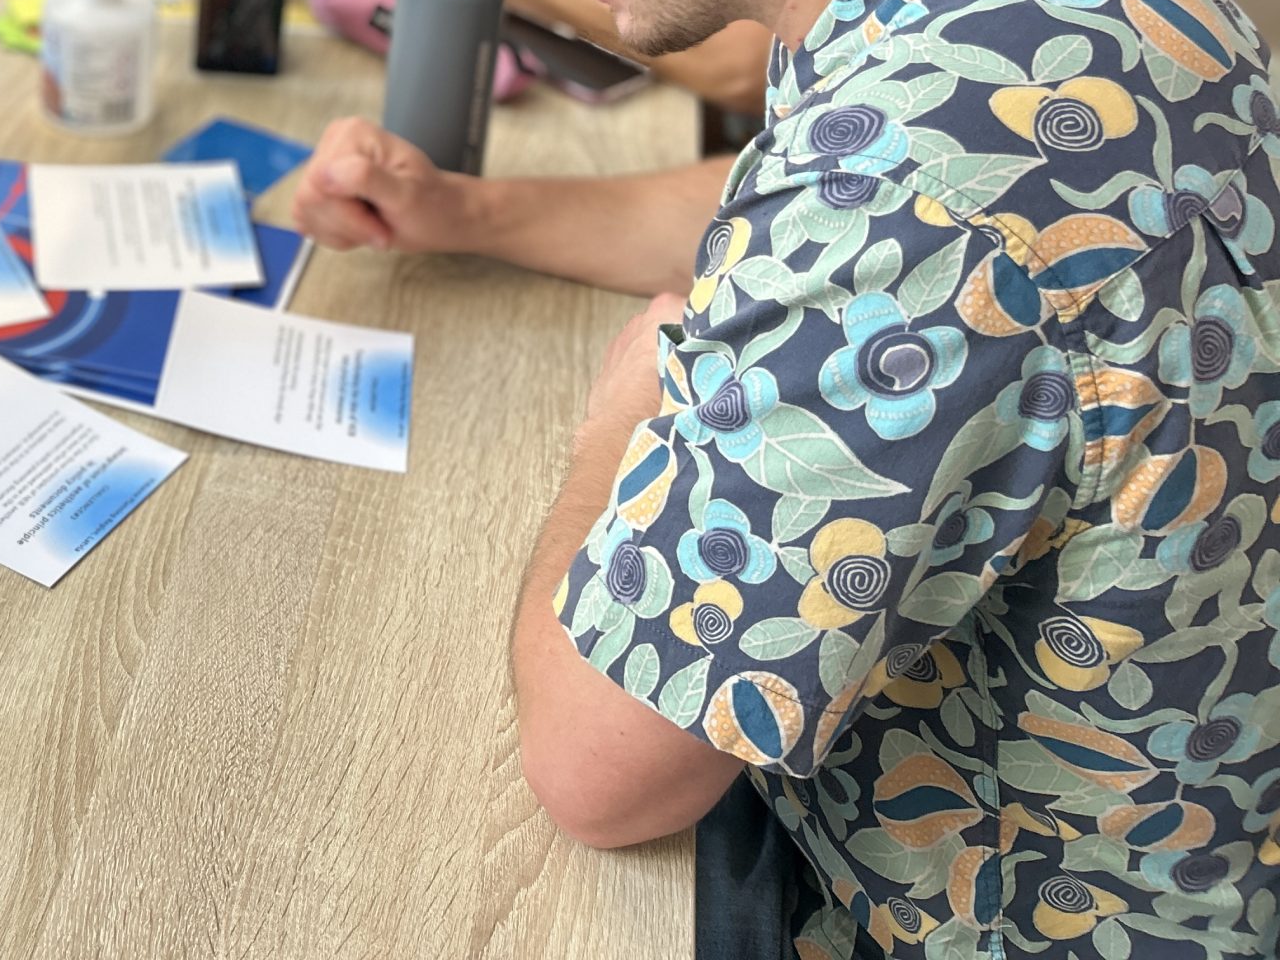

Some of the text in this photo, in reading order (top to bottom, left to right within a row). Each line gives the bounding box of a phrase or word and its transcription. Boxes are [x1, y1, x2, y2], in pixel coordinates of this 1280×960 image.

[62, 465, 89, 486] policy
[28, 484, 70, 520] documents
[45, 485, 85, 519] aesthetics
[11, 514, 51, 546] principle
[73, 535, 94, 552] Latvia
